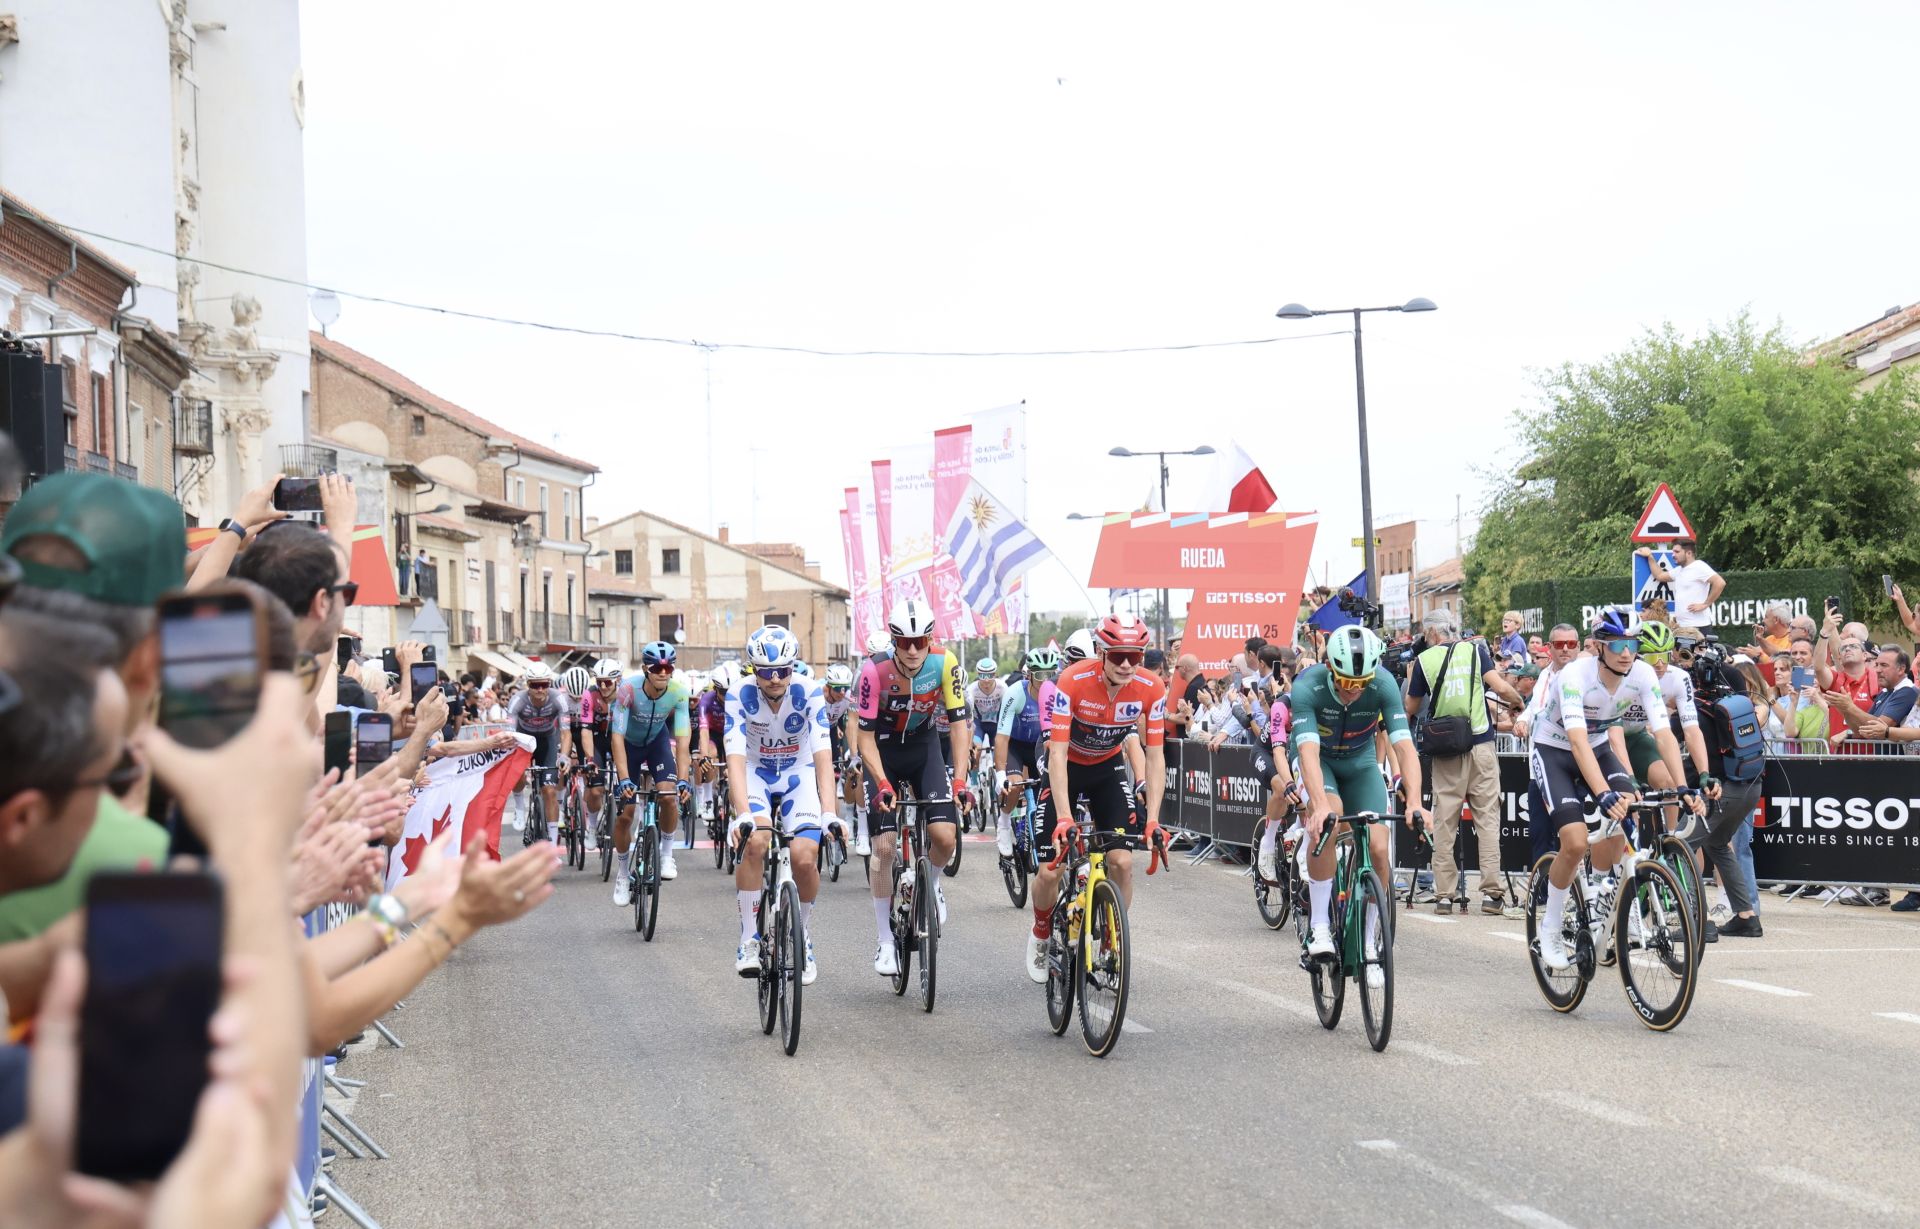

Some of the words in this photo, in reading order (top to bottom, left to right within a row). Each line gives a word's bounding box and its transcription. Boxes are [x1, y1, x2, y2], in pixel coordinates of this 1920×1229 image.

[1180, 547, 1226, 568] RUEDA
[1229, 592, 1287, 604] TISSOT
[1197, 624, 1213, 639] LA
[1215, 624, 1261, 639] VUELTA
[1263, 624, 1279, 639] 25
[1198, 659, 1232, 671] arrefo
[915, 678, 937, 692] caps
[1095, 727, 1127, 738] VISMA
[760, 735, 800, 748] UAE
[1227, 776, 1262, 803] TISSOT
[1034, 802, 1047, 835] VISMA
[1763, 834, 1838, 845] WATCHES
[1846, 835, 1895, 846] SINCE
[1903, 836, 1920, 847] 18
